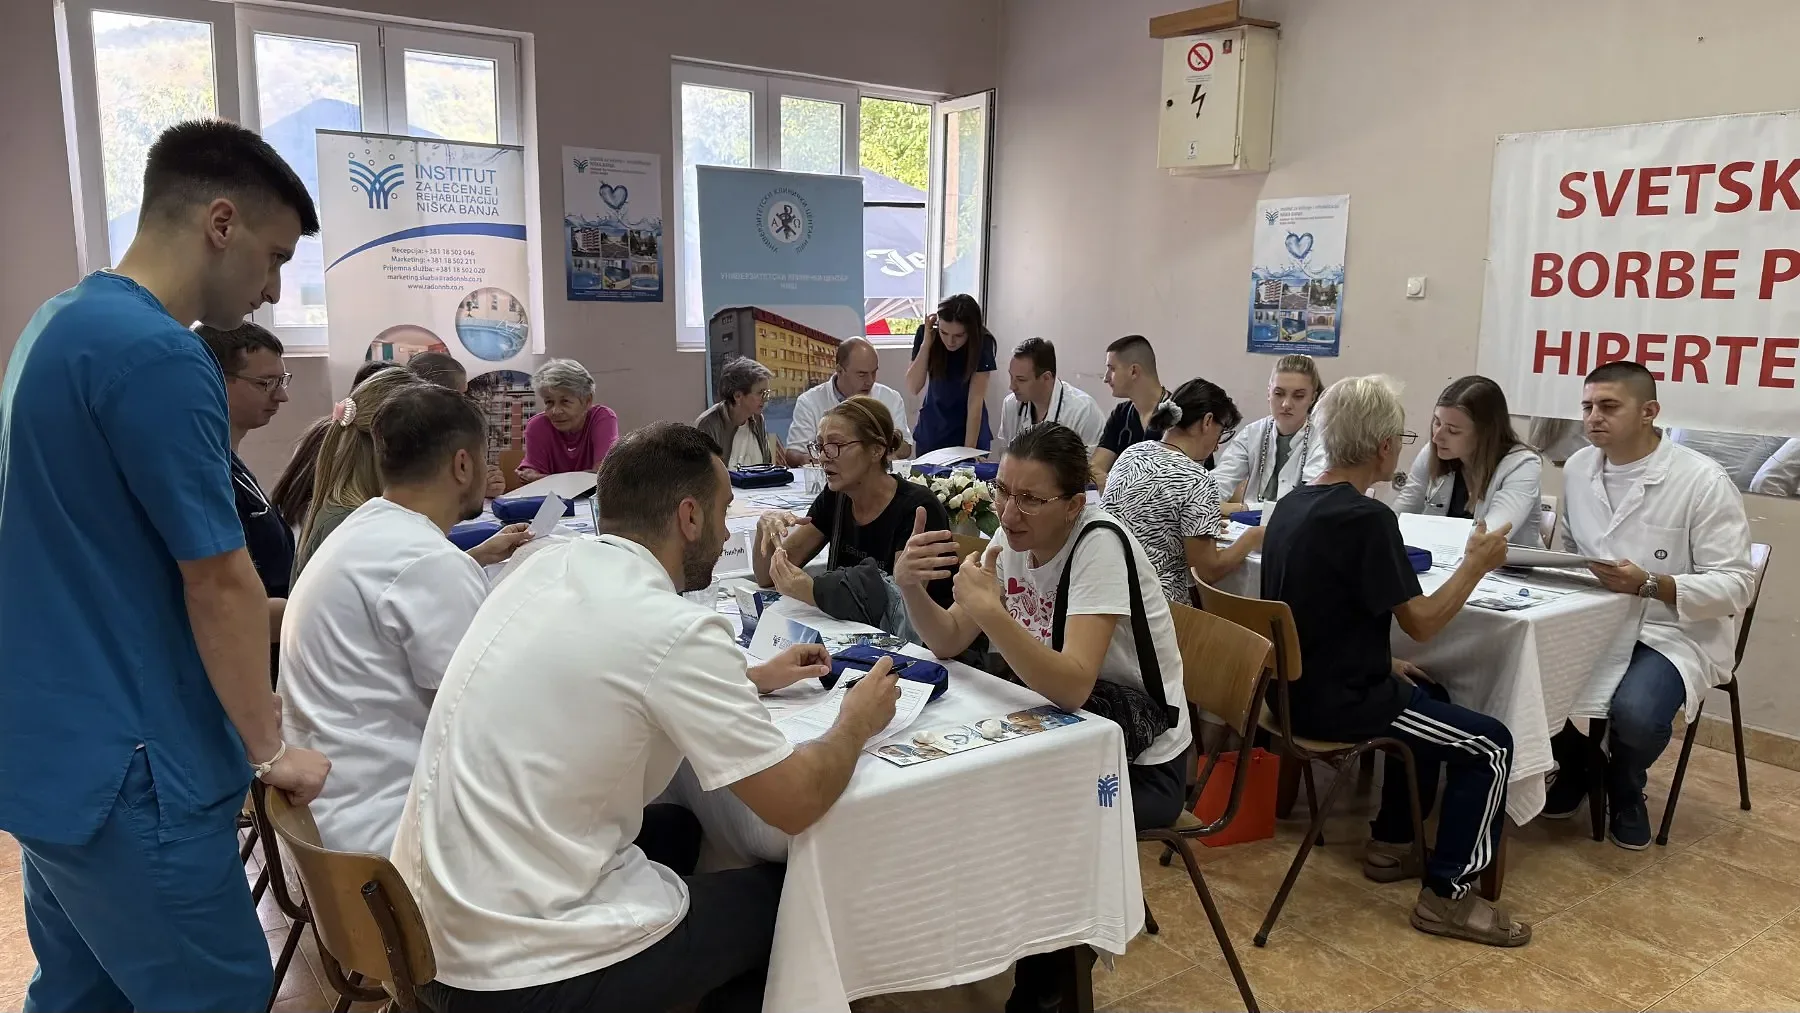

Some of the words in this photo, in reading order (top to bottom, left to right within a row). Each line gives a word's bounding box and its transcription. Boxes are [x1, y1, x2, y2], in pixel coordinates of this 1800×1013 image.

[415, 165, 496, 184] INSTITUT
[416, 181, 432, 192] ZA
[436, 182, 491, 196] LEČENJE
[1556, 158, 1800, 220] SVETSK
[416, 193, 499, 206] REHABILITACIJU
[417, 201, 456, 214] NIŠKA
[460, 205, 499, 217] BANJA
[392, 247, 424, 255] Recepcija:
[391, 256, 426, 264] Marketing:
[1530, 249, 1740, 299] BORBE
[1758, 248, 1800, 299] P
[1532, 329, 1800, 389] HIPERTE
